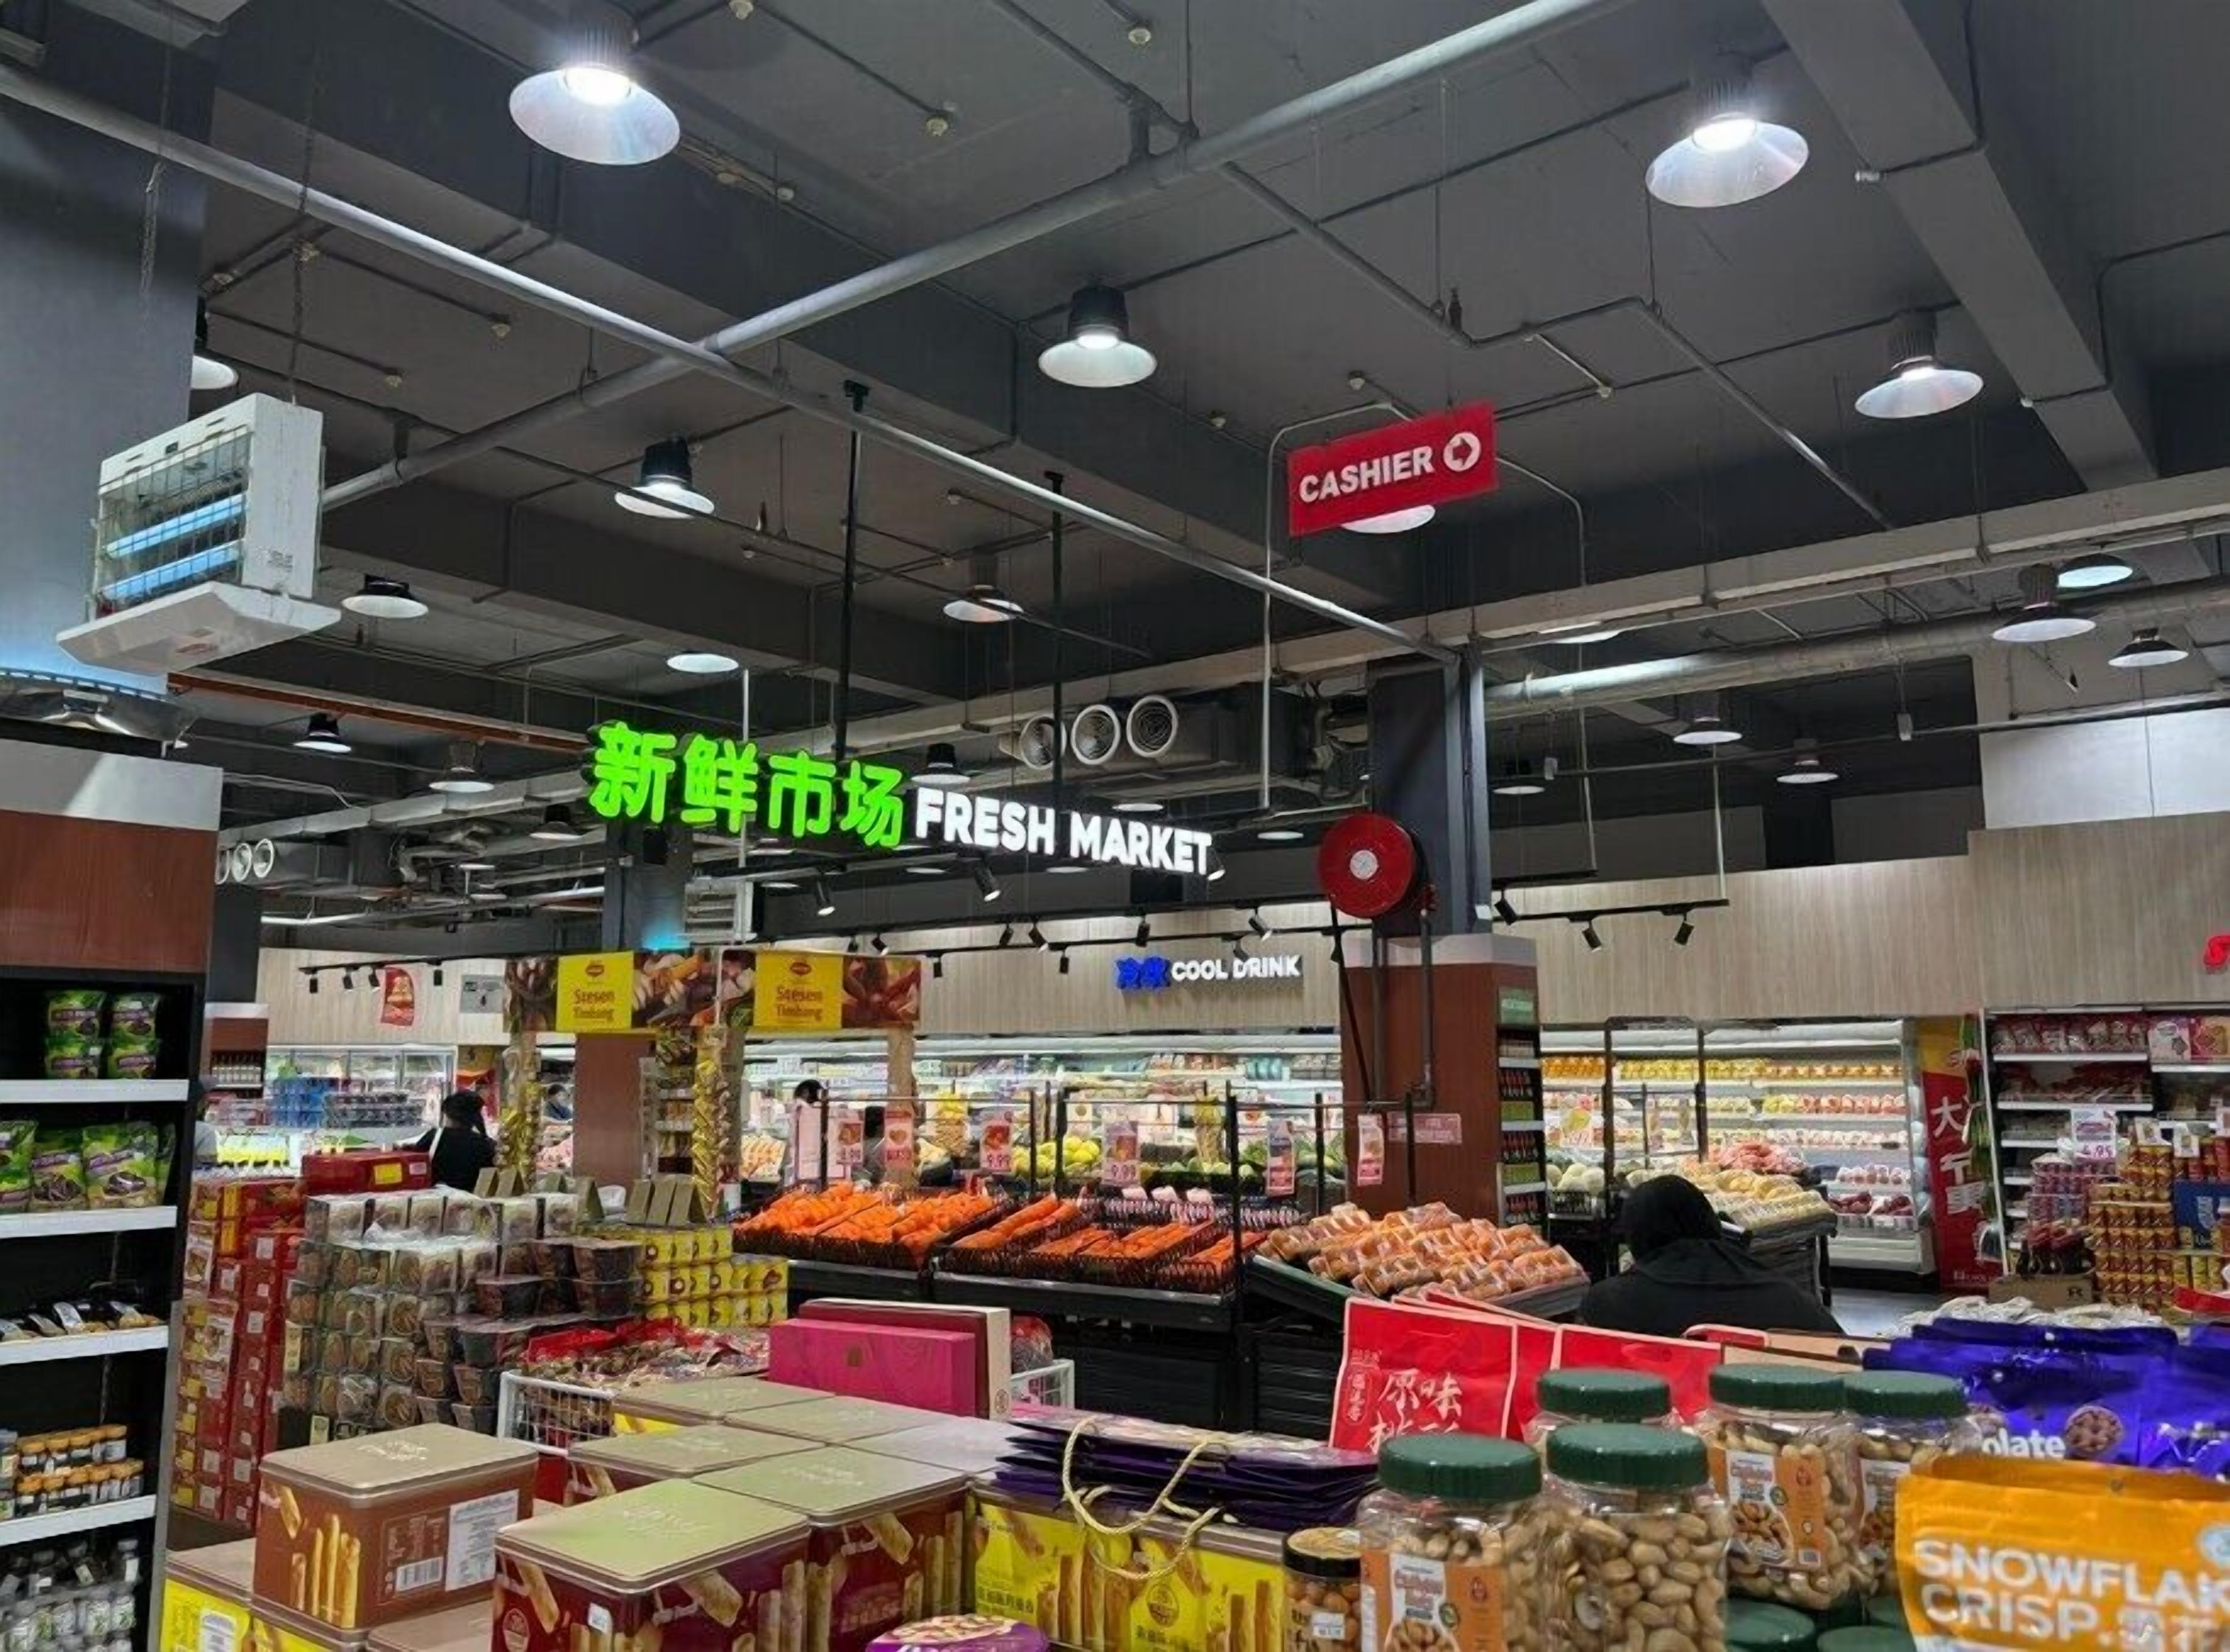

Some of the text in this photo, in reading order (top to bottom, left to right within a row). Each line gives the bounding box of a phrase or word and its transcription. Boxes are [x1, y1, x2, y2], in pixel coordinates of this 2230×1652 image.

[1299, 446, 1434, 503] CASHIER
[589, 721, 904, 847] 新鲜市场
[916, 787, 1212, 875] FRESH MARKET
[1172, 959, 1228, 981] COOL
[1233, 954, 1301, 978] DRINK
